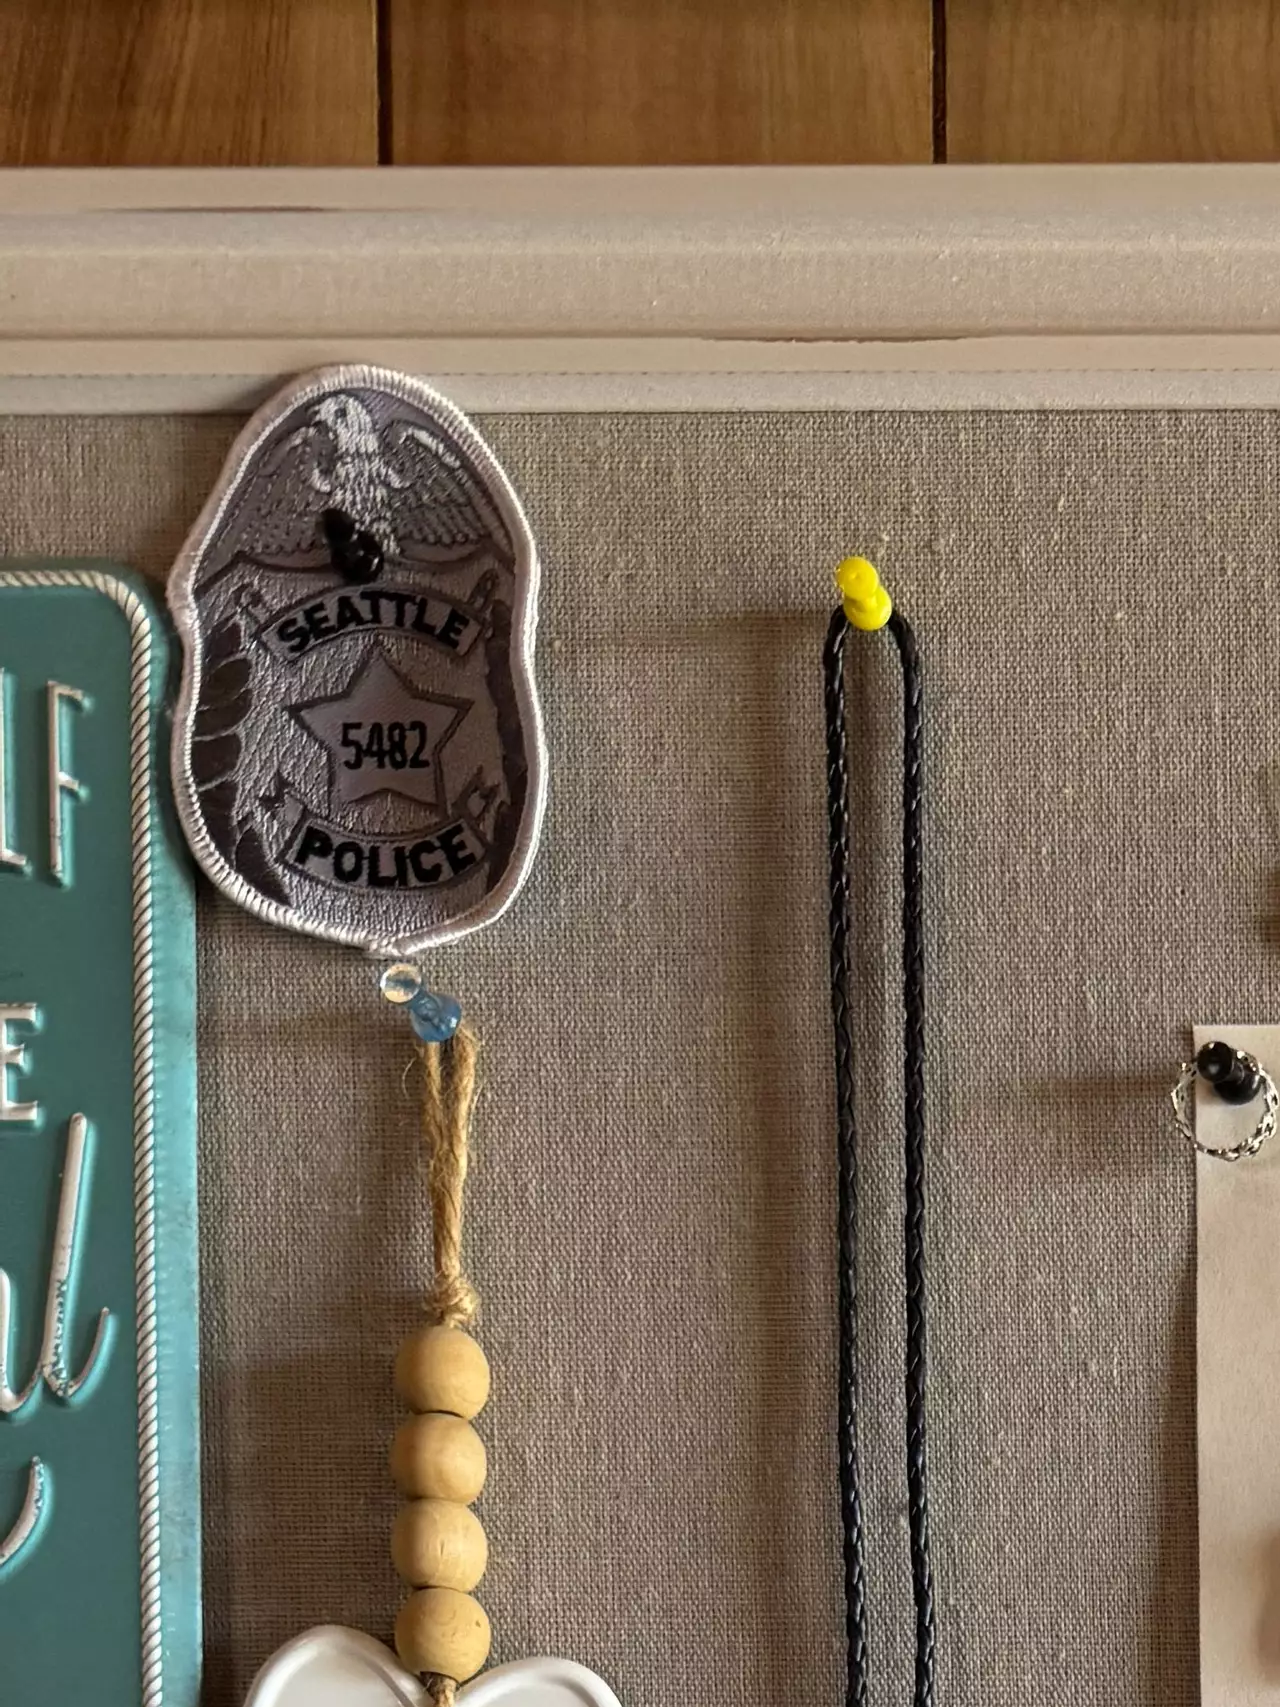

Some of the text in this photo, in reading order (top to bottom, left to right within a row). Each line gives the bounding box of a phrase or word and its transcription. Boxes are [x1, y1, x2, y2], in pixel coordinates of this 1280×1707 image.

[278, 591, 466, 651] SEATTLE
[341, 721, 429, 771] 5482
[293, 824, 477, 887] POLICE
